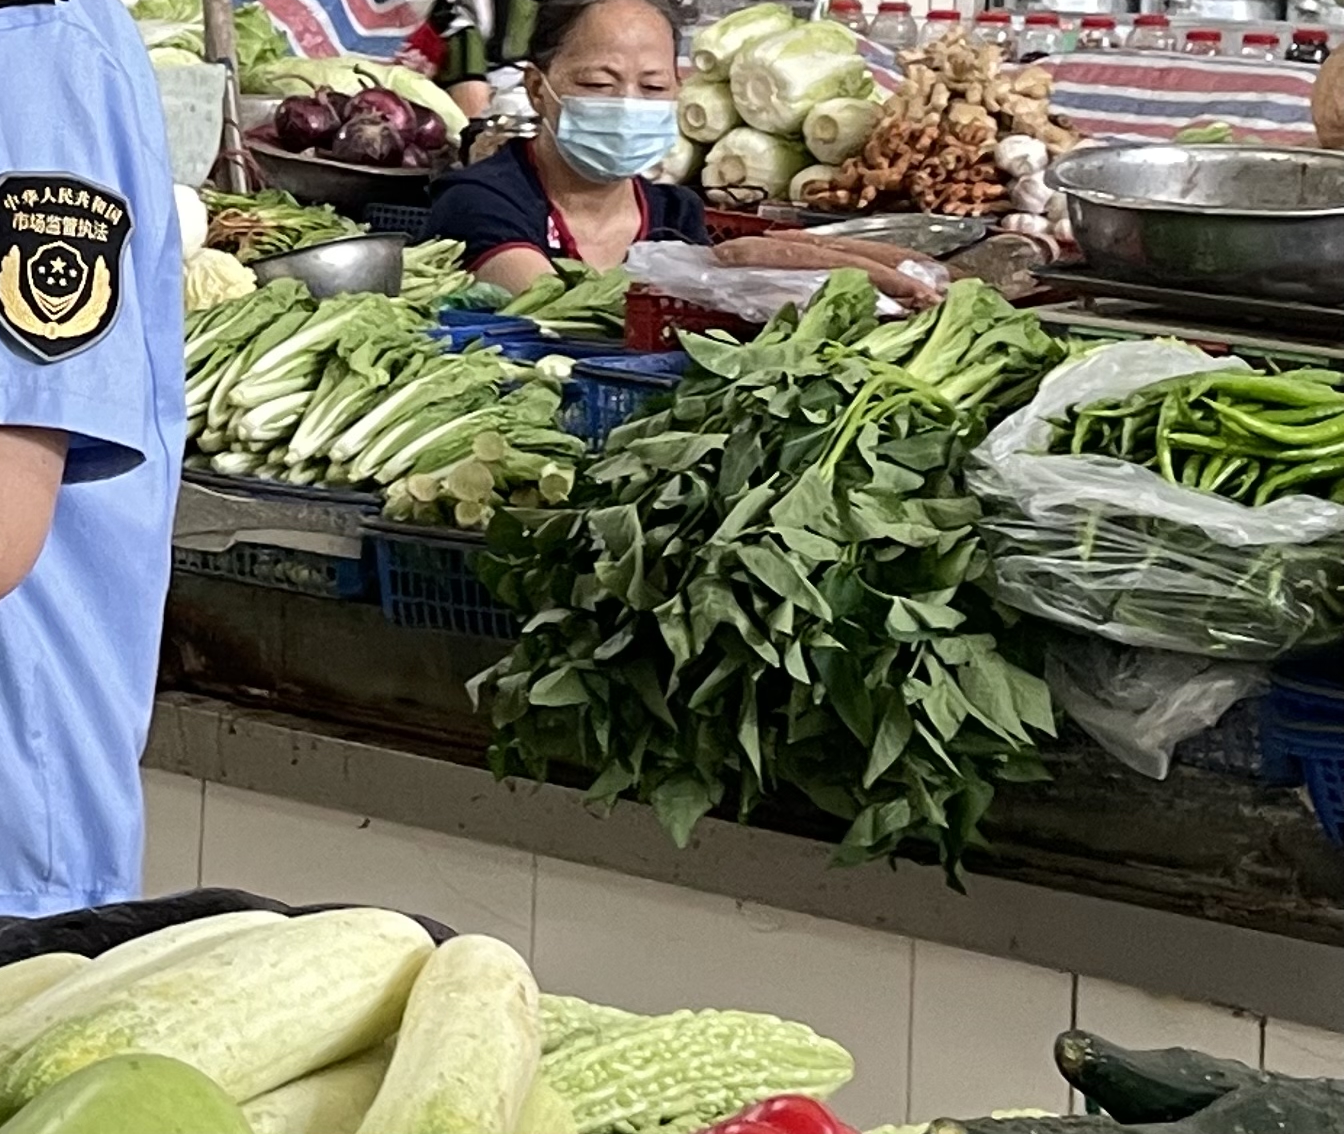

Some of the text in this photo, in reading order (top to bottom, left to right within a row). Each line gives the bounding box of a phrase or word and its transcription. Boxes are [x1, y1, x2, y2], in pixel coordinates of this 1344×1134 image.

[3, 187, 123, 225] 中华人民共和国
[12, 211, 109, 242] 市场监管执法
